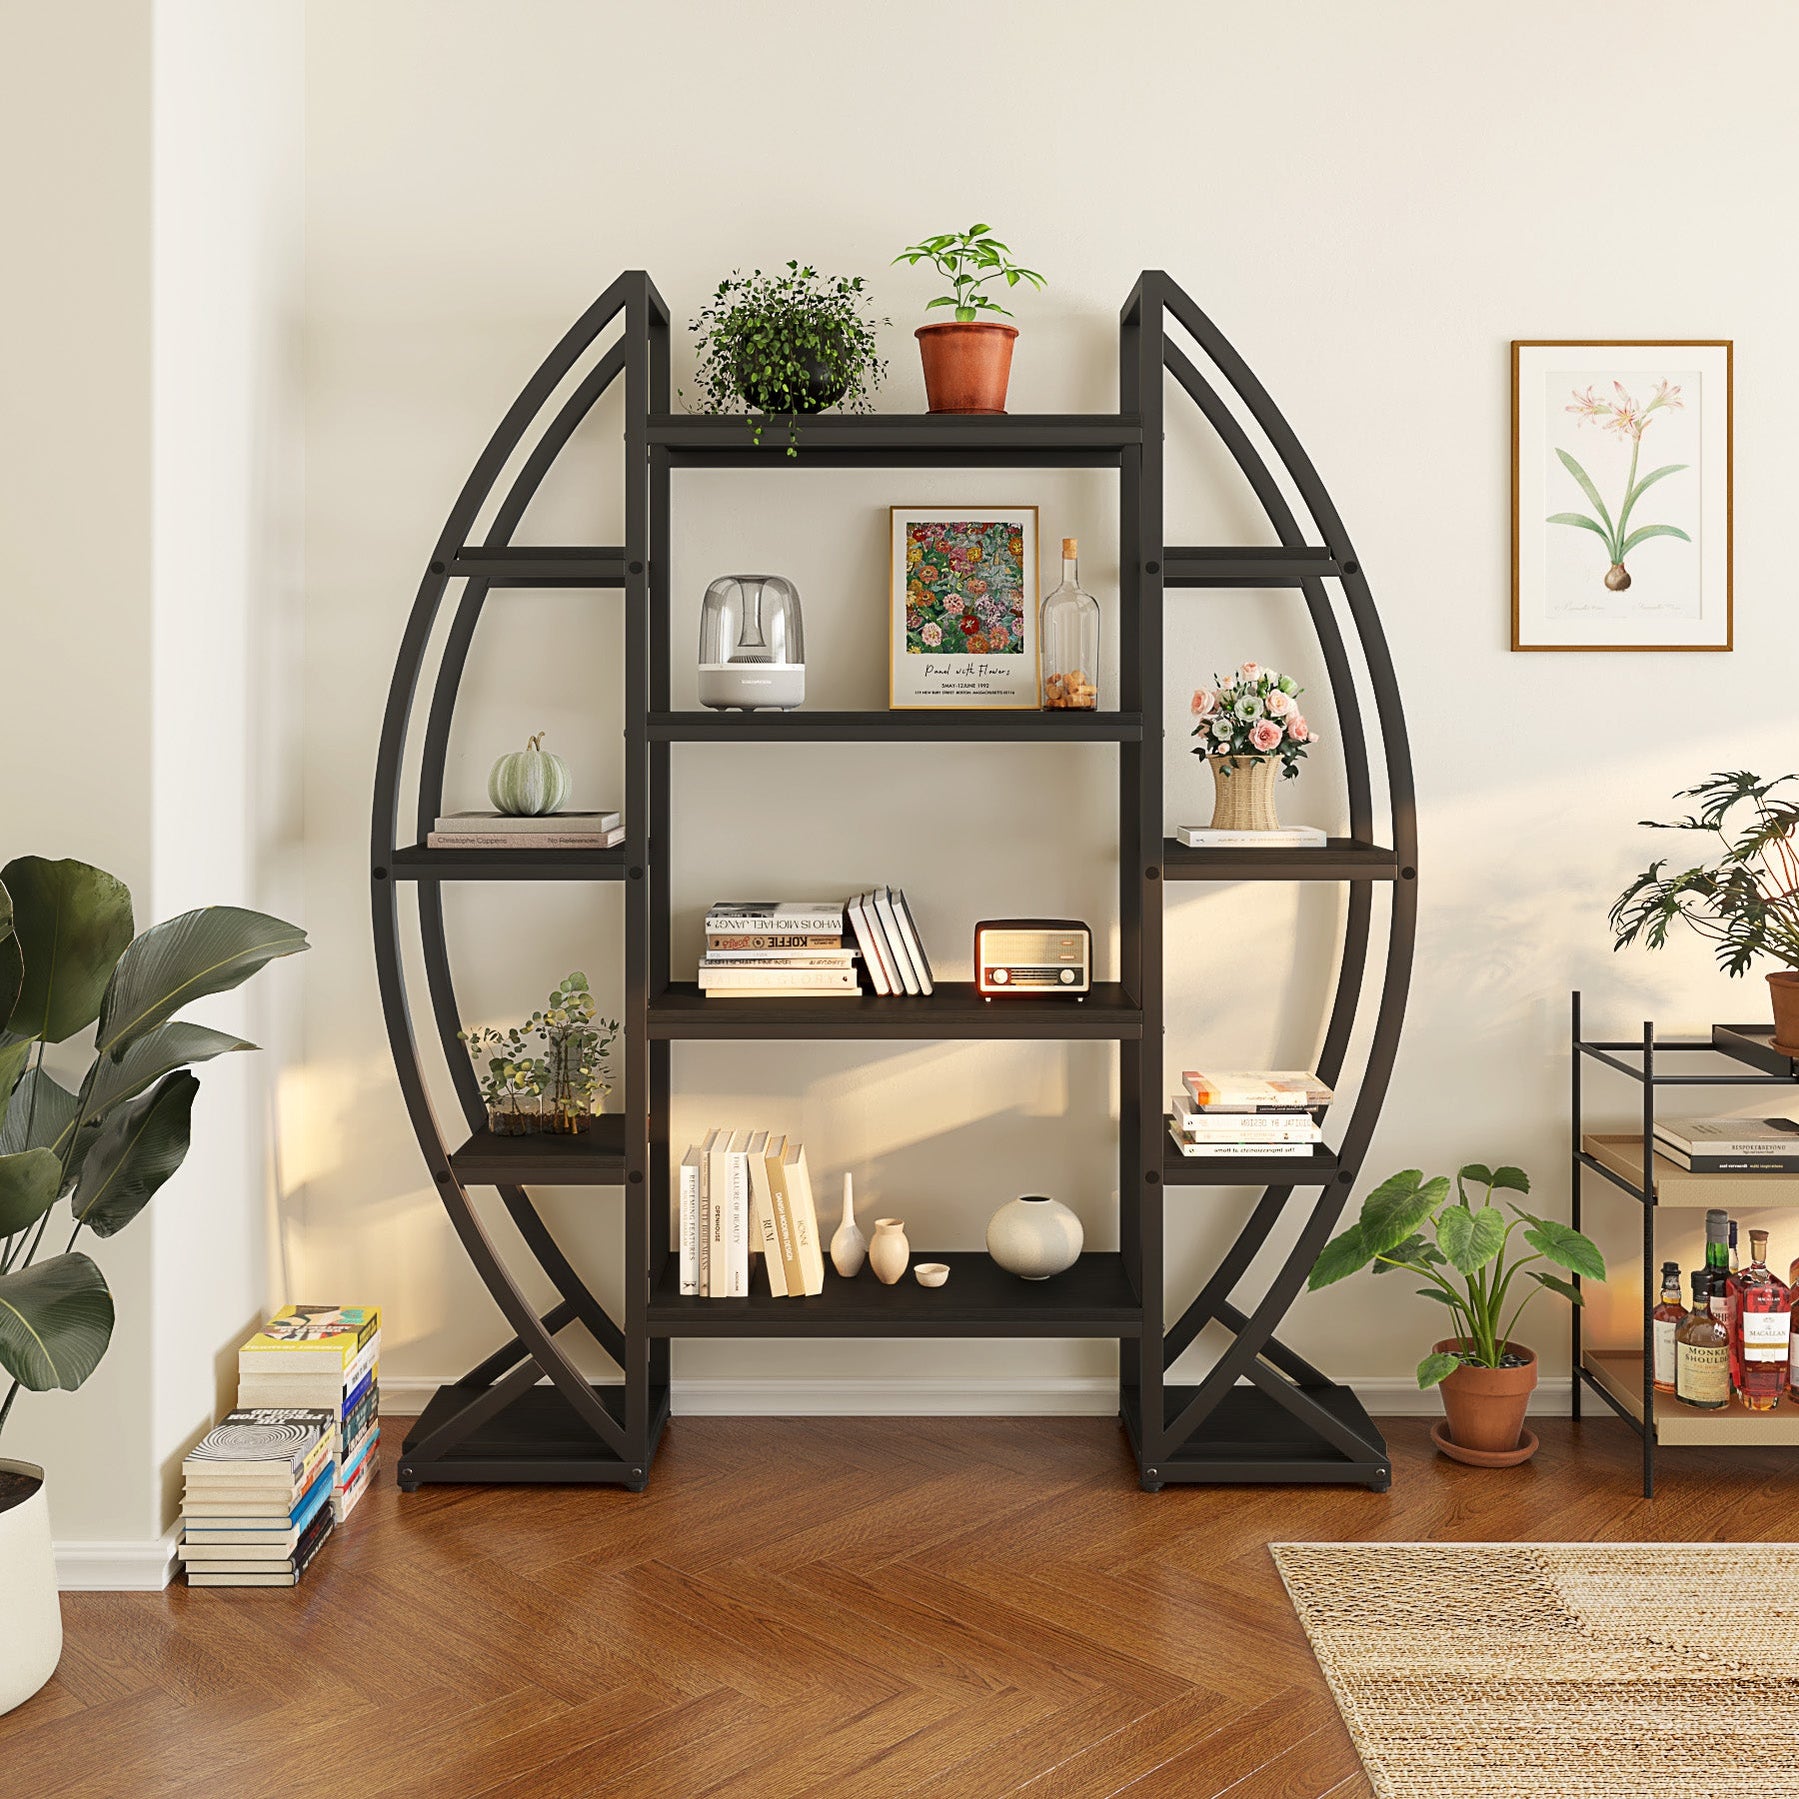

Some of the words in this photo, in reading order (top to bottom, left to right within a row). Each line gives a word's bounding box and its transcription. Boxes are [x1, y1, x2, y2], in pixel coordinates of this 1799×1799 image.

[956, 662, 975, 676] with
[979, 664, 1010, 677] Flowers
[437, 836, 476, 844] Christophe
[476, 837, 508, 845] Coppens
[714, 920, 750, 930] JANG?
[753, 920, 799, 929] MICHAEL
[801, 920, 811, 929] IS
[813, 920, 842, 929] WHO
[768, 936, 808, 948] KOFFIE
[733, 1202, 740, 1211] OF
[775, 1192, 785, 1214] DANISH
[762, 1218, 774, 1242] RUM
[779, 1214, 788, 1240] MODERN
[783, 1240, 793, 1262] DESIGN
